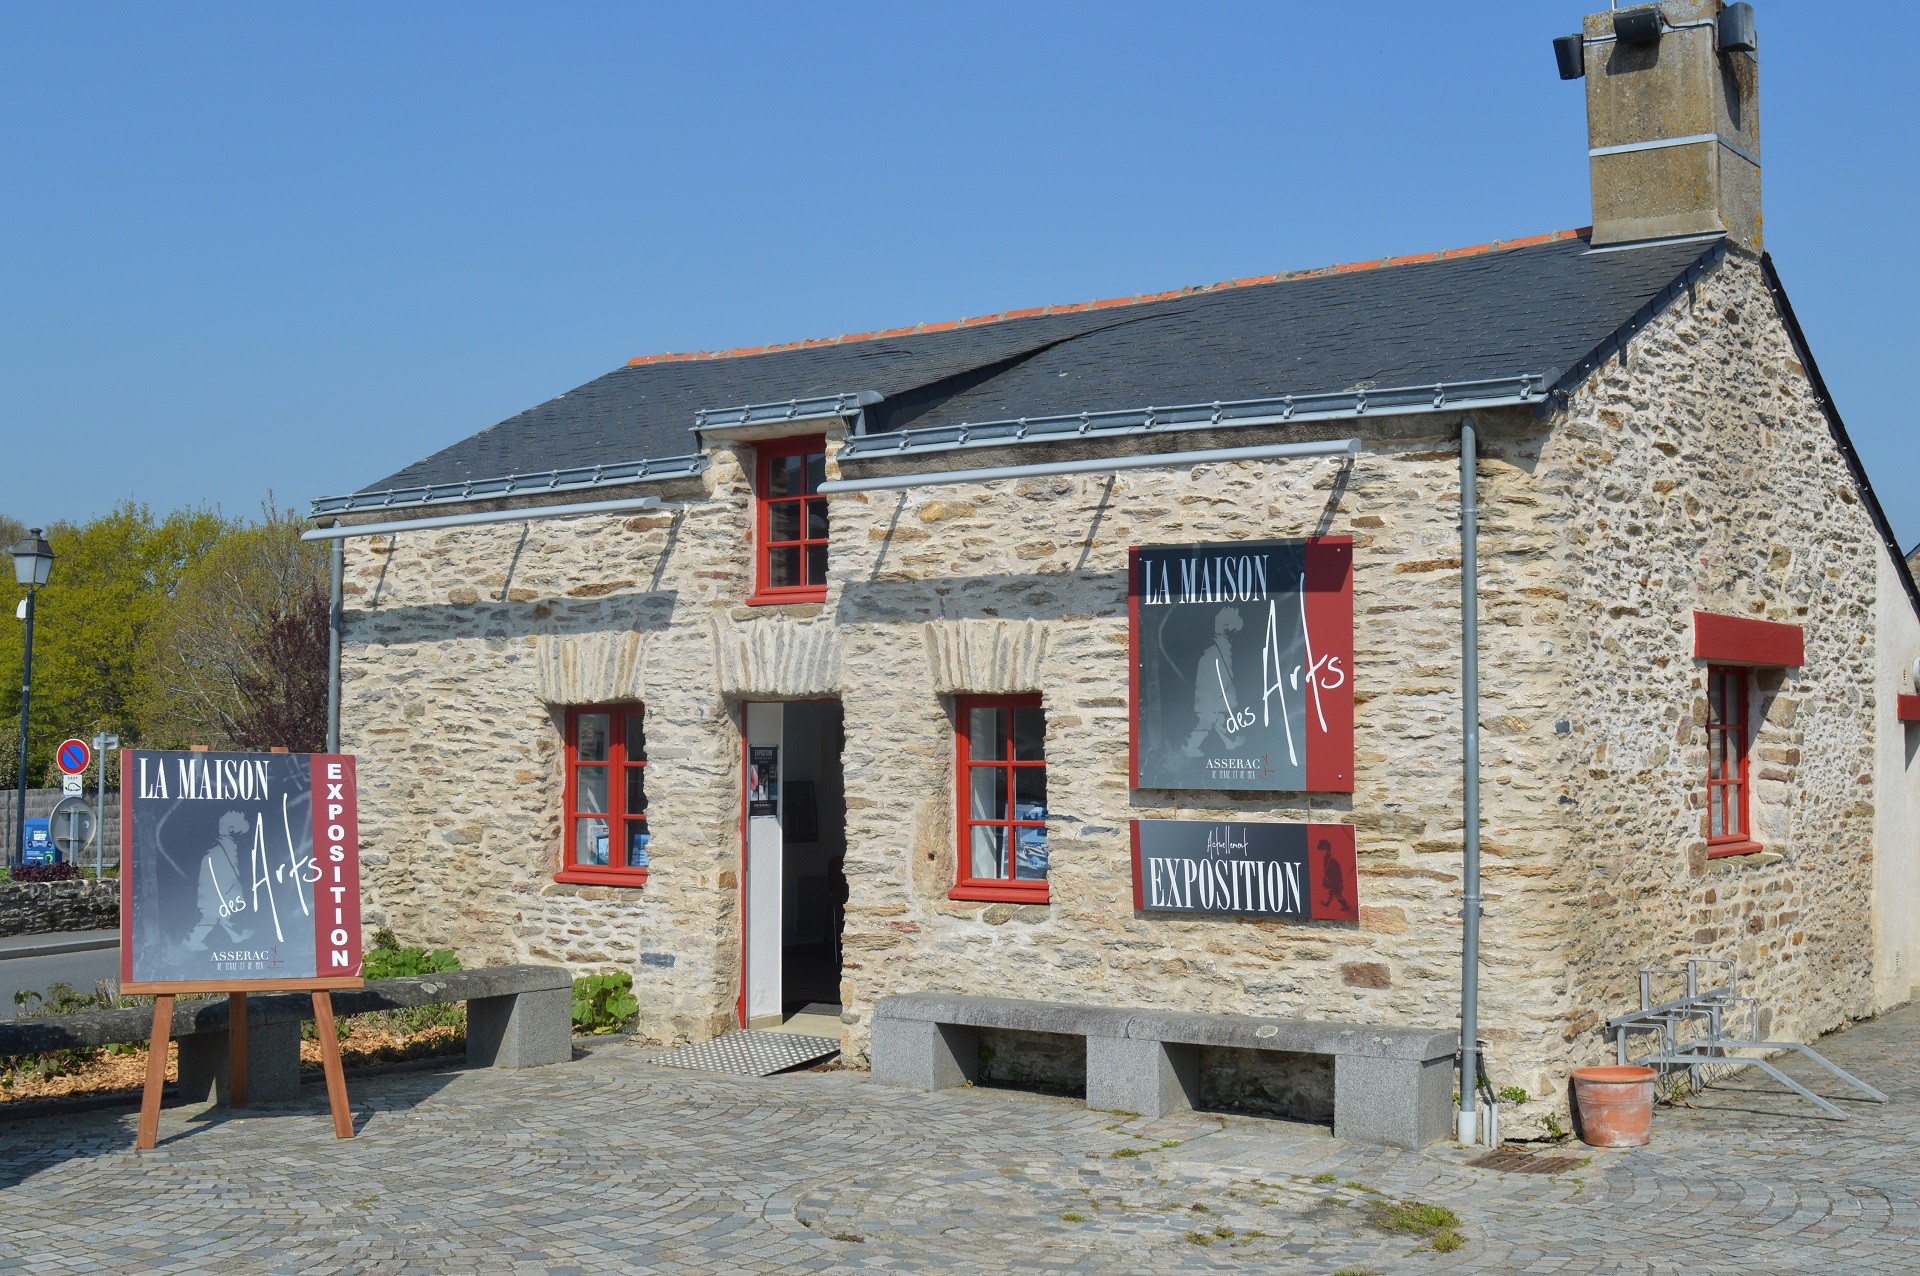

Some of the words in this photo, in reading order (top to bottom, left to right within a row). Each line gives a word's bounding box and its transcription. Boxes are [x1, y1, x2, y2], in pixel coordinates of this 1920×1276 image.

[1144, 559, 1172, 605] LA
[1179, 554, 1270, 604] MAISON
[1215, 658, 1256, 734] des
[1262, 572, 1345, 767] Arts
[138, 757, 169, 799] LA
[177, 758, 270, 801] MAISON
[1205, 758, 1261, 770] ASSERAC
[208, 857, 246, 917] des
[251, 792, 323, 943] Arts
[326, 763, 349, 967] EXPOSITION
[1207, 825, 1249, 860] Actuellement
[1148, 857, 1302, 914] EXPOSITION
[210, 950, 269, 962] ASSERAC
